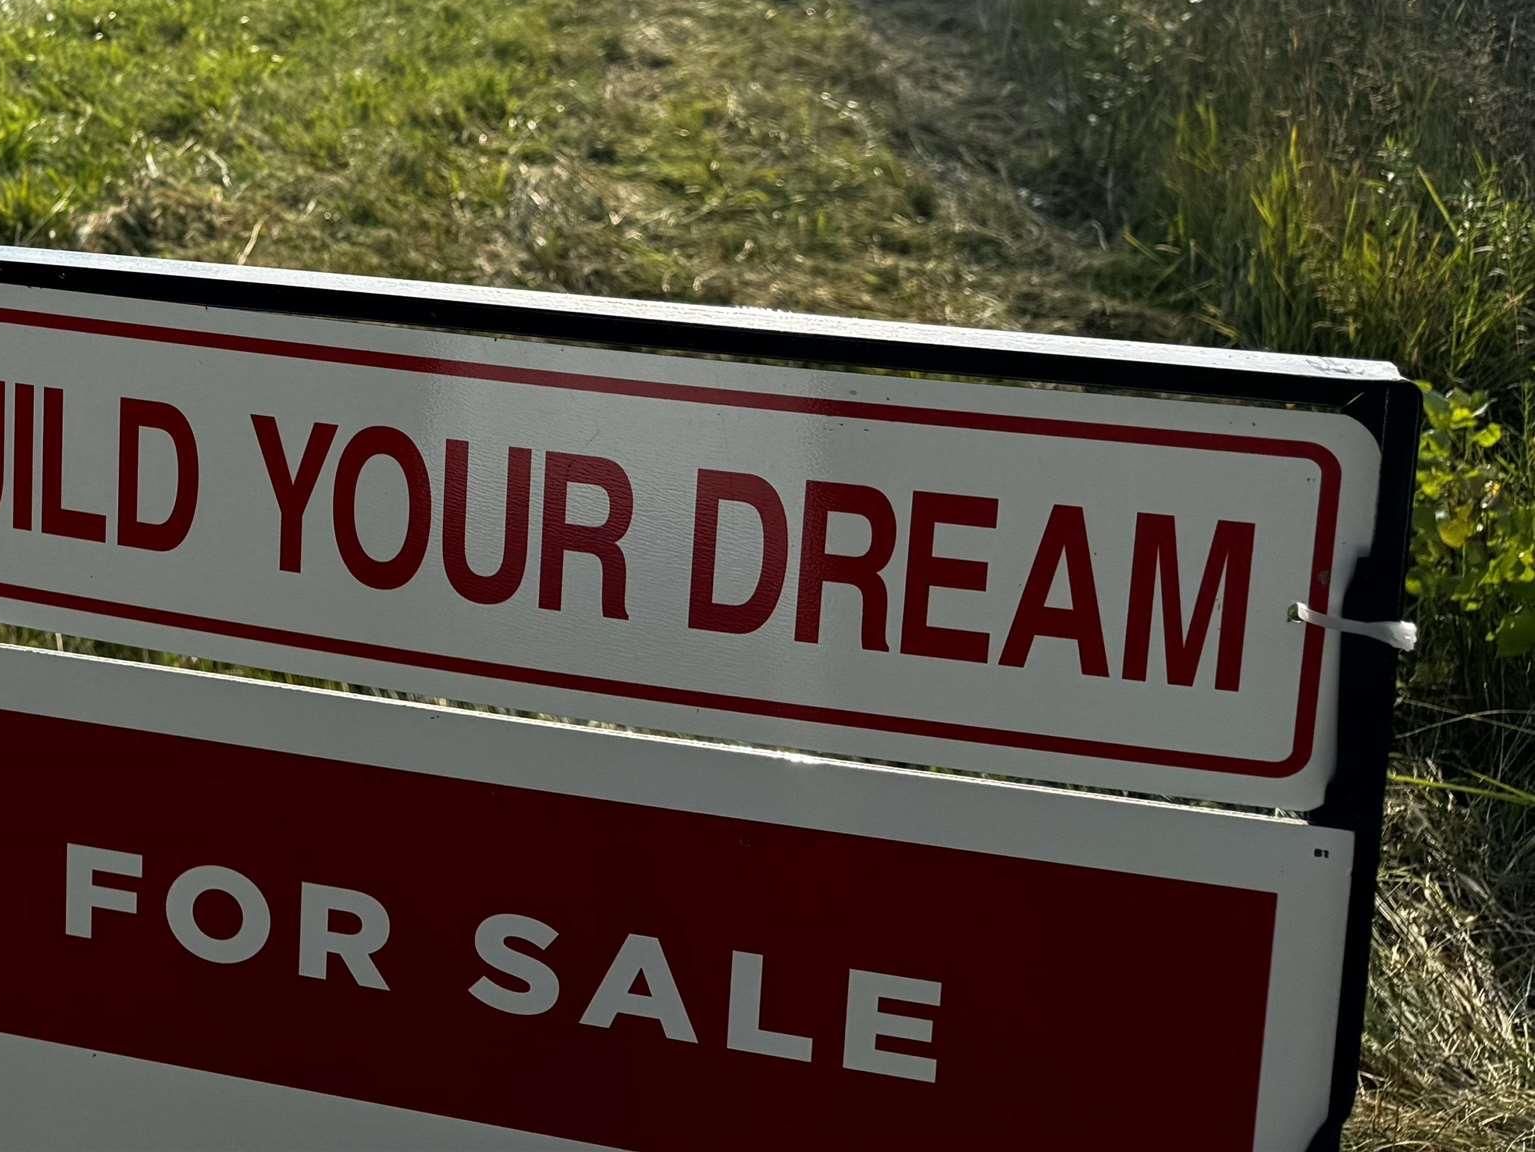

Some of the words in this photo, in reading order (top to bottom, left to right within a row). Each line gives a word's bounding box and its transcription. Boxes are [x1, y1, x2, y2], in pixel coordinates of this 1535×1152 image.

[250, 414, 633, 620] YOUR
[688, 468, 1257, 692] DREAM
[65, 842, 390, 991] FOR
[468, 913, 943, 1084] SALE
